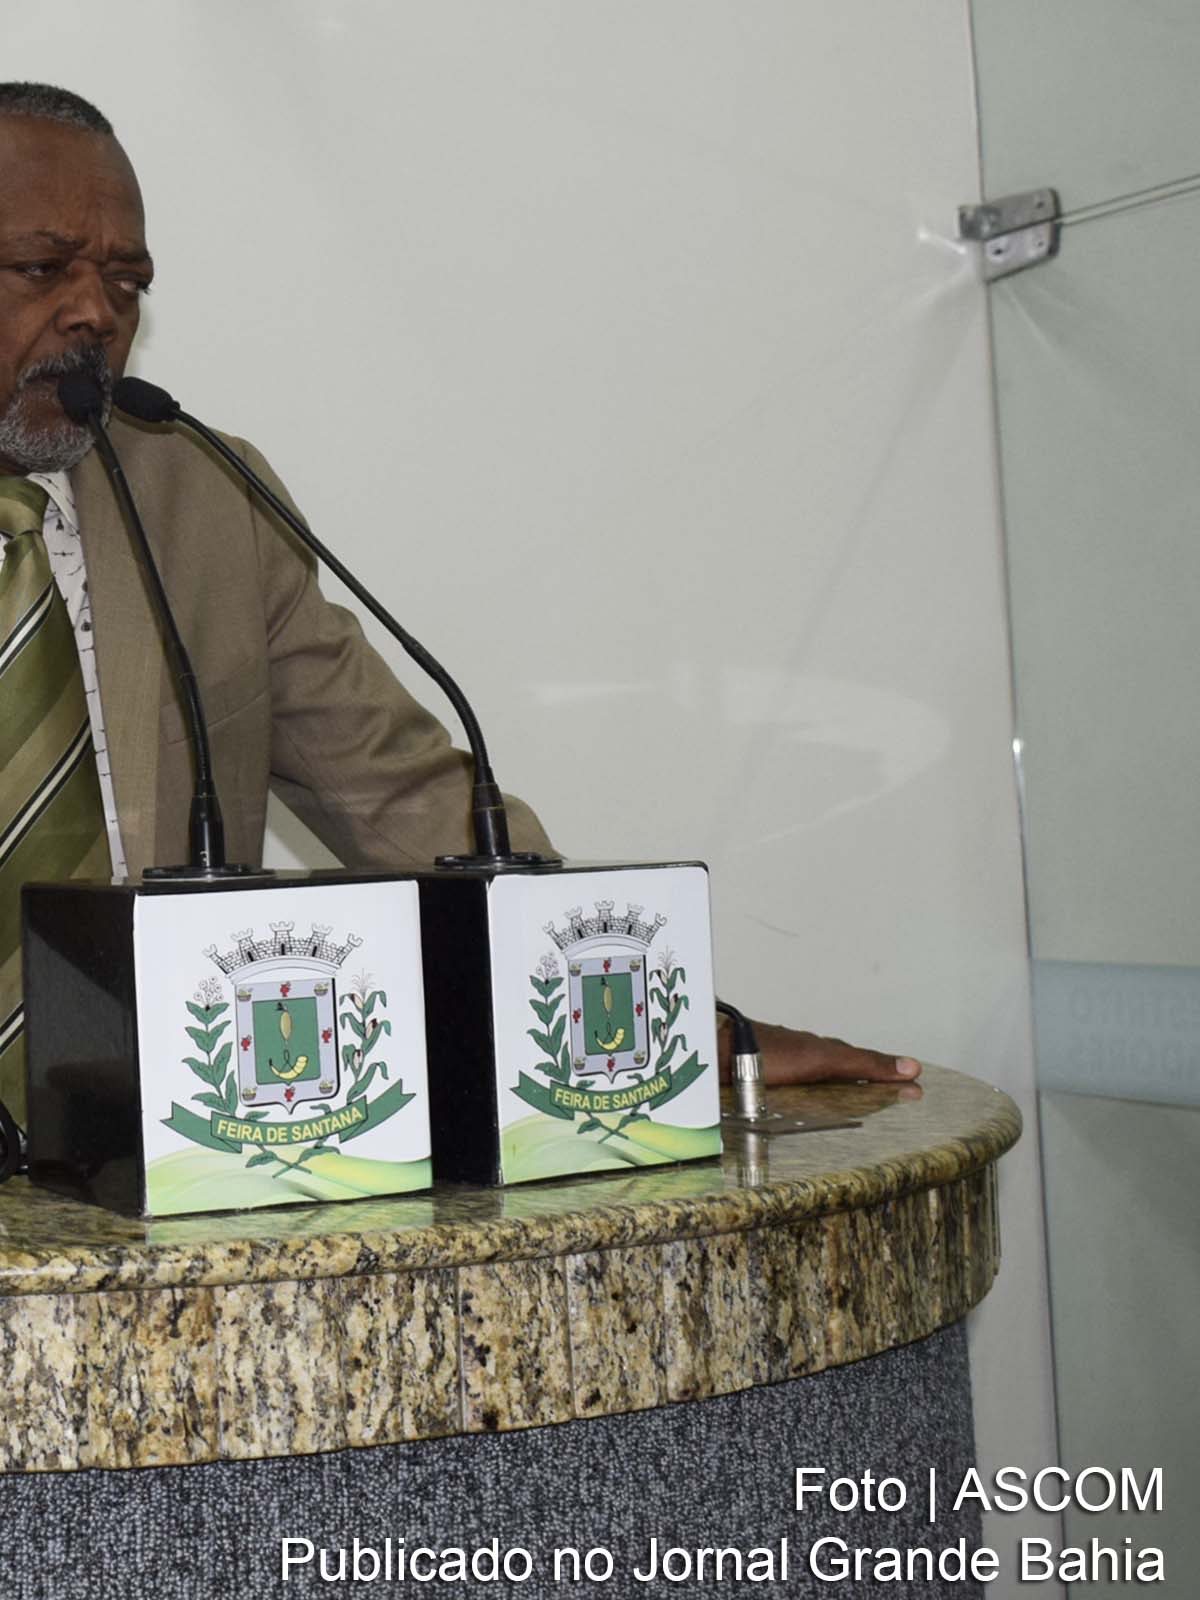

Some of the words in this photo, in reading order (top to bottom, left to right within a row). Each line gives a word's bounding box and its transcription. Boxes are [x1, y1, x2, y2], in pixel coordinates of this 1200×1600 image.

[554, 1088, 591, 1110] FEIRA
[593, 1095, 610, 1110] DE
[612, 1076, 668, 1108] SANTANA
[217, 1119, 263, 1143] FEIRA
[266, 1126, 288, 1142] DE
[291, 1107, 363, 1139] SANTANA
